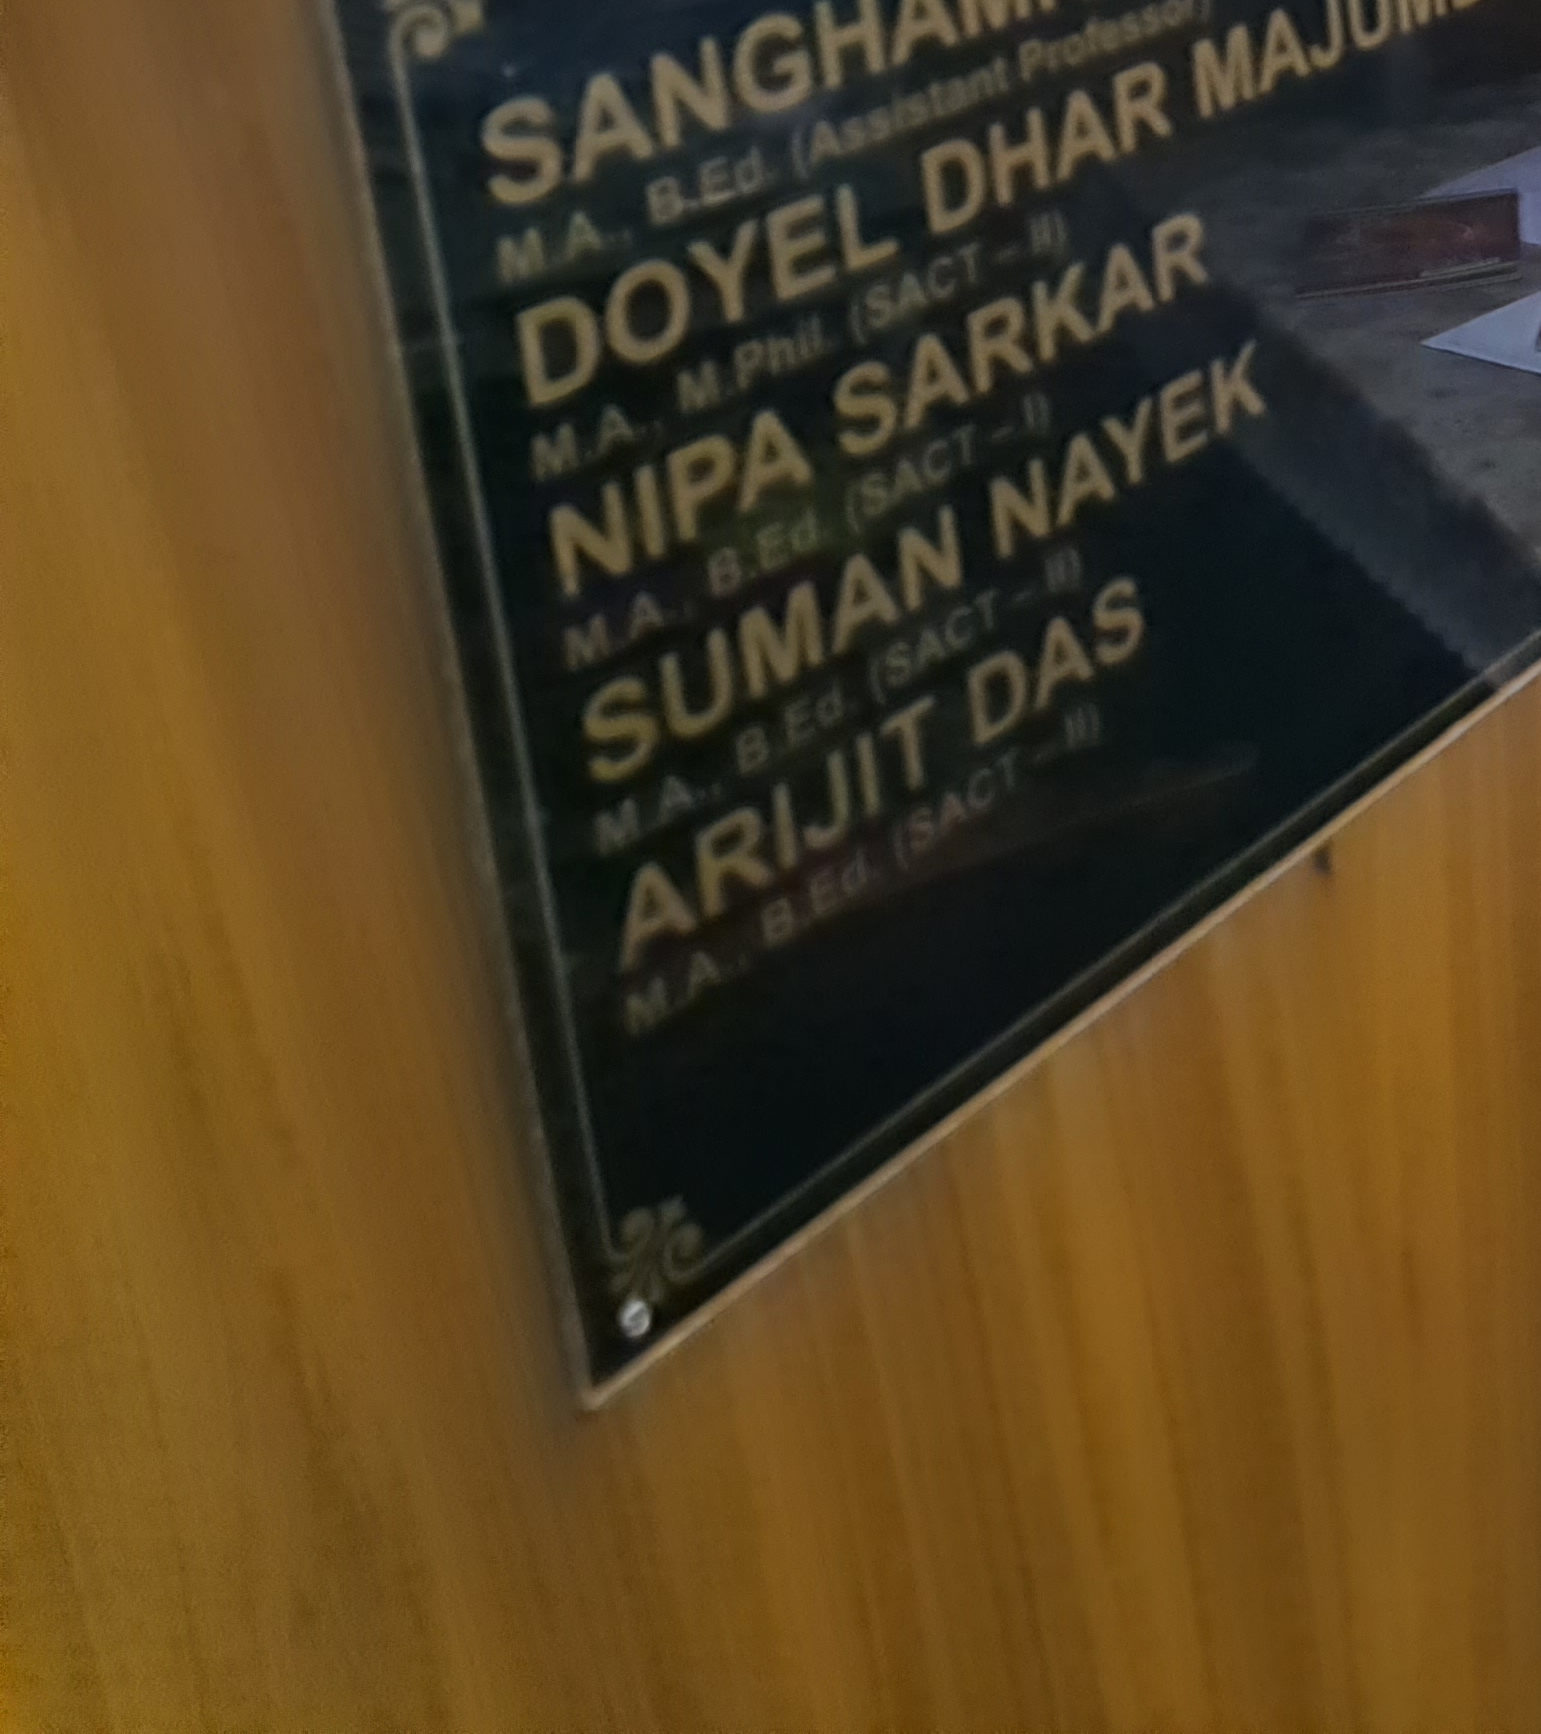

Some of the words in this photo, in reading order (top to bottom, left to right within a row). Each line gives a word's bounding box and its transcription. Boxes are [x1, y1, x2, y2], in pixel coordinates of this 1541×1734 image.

[787, 55, 1010, 179] (Assistant
[517, 182, 898, 406] DOYEL
[920, 60, 1172, 234] DHAR
[850, 241, 979, 341] (SACT
[549, 408, 813, 597] NIPA
[834, 209, 1209, 455] SARKAR
[844, 425, 972, 535] (SACT
[583, 504, 962, 781] SUMAN
[989, 339, 1266, 557] NAYEK
[869, 588, 996, 702] (SACT
[620, 694, 935, 968] ARIJIT
[967, 576, 1144, 746] DAS
[893, 752, 1013, 868] (SACT
